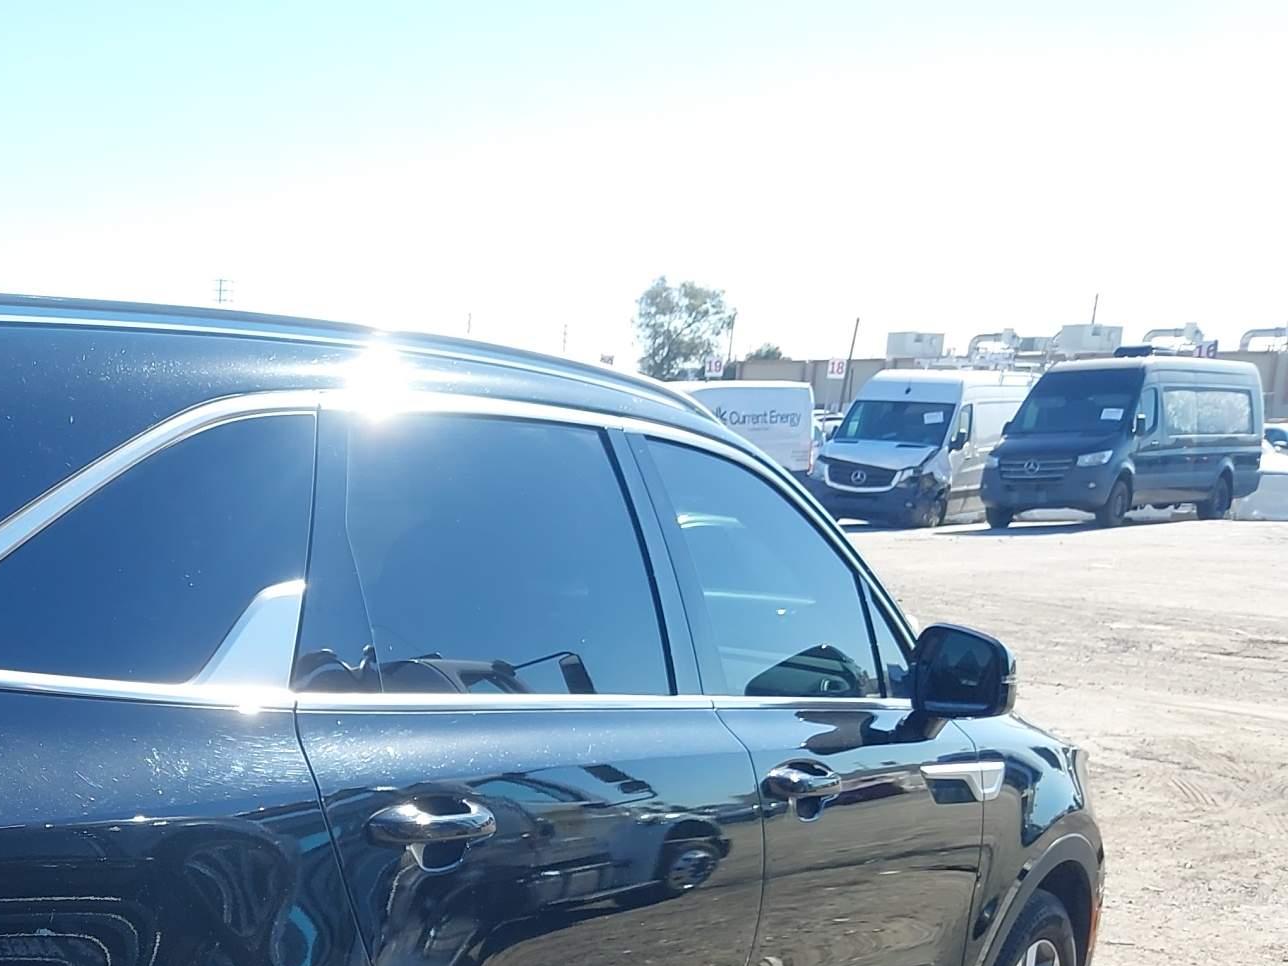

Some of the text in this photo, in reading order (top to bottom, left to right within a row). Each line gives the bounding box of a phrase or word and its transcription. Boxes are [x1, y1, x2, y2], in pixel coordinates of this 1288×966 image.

[706, 360, 722, 373] 19
[828, 360, 845, 375] 18
[729, 410, 801, 427] Current Energy
